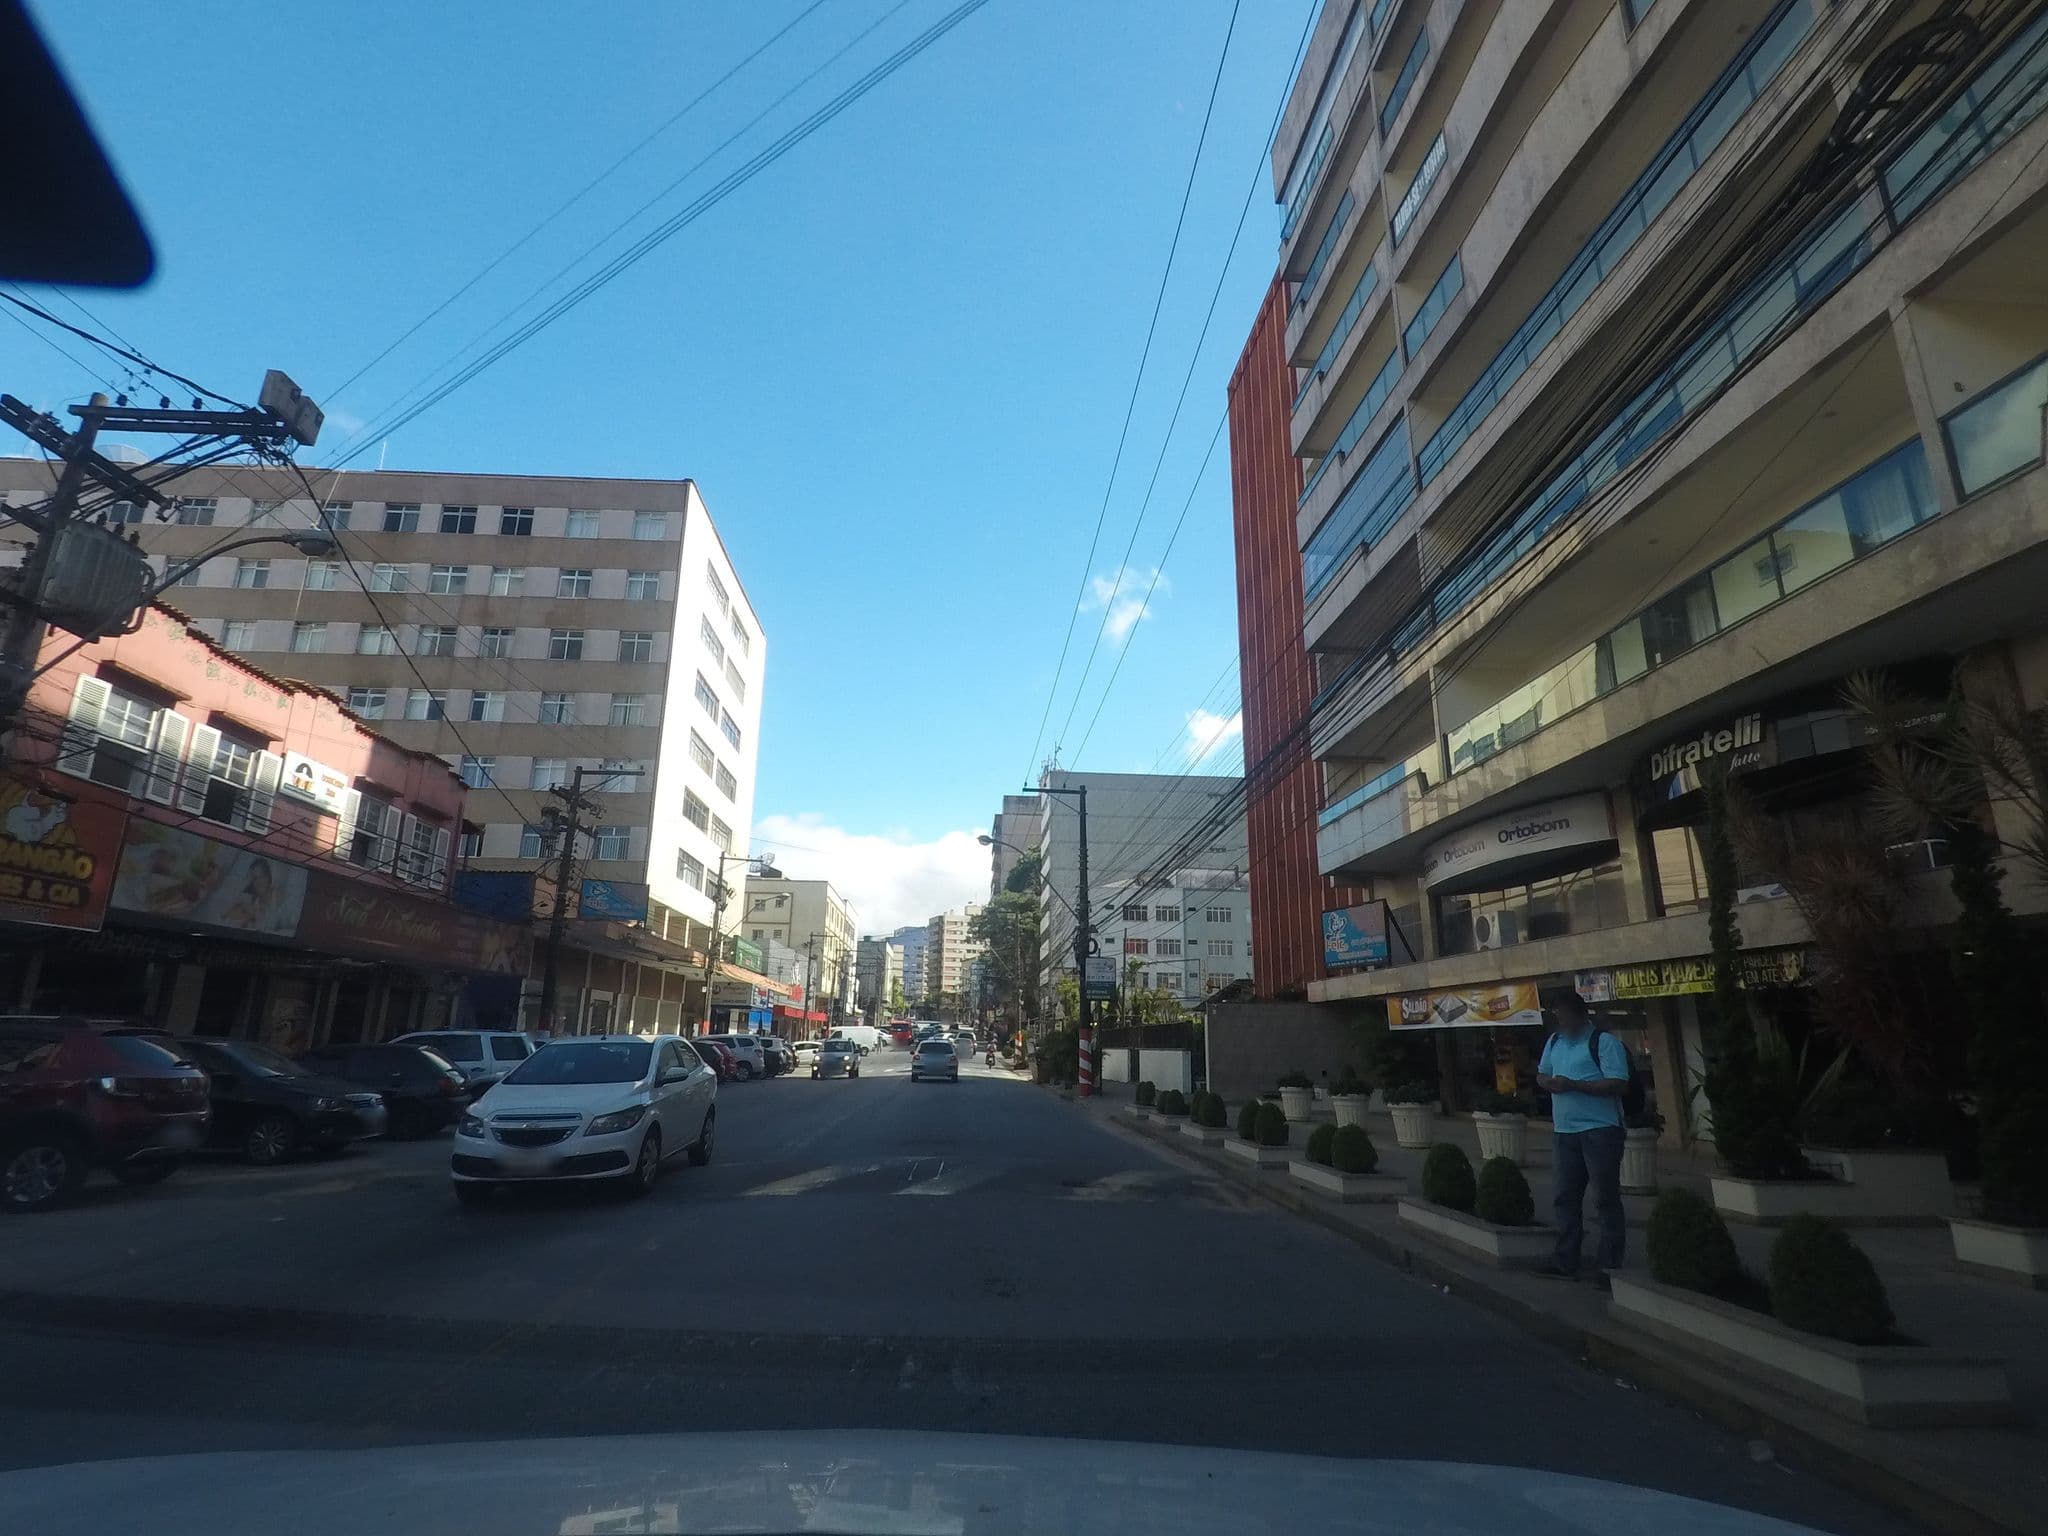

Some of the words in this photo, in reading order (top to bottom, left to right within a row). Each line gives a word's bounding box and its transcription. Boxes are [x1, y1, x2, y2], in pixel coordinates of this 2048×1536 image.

[1650, 712, 1761, 781] Difratelli
[1497, 818, 1570, 844] Ortobom
[1443, 840, 1486, 863] Ortobom
